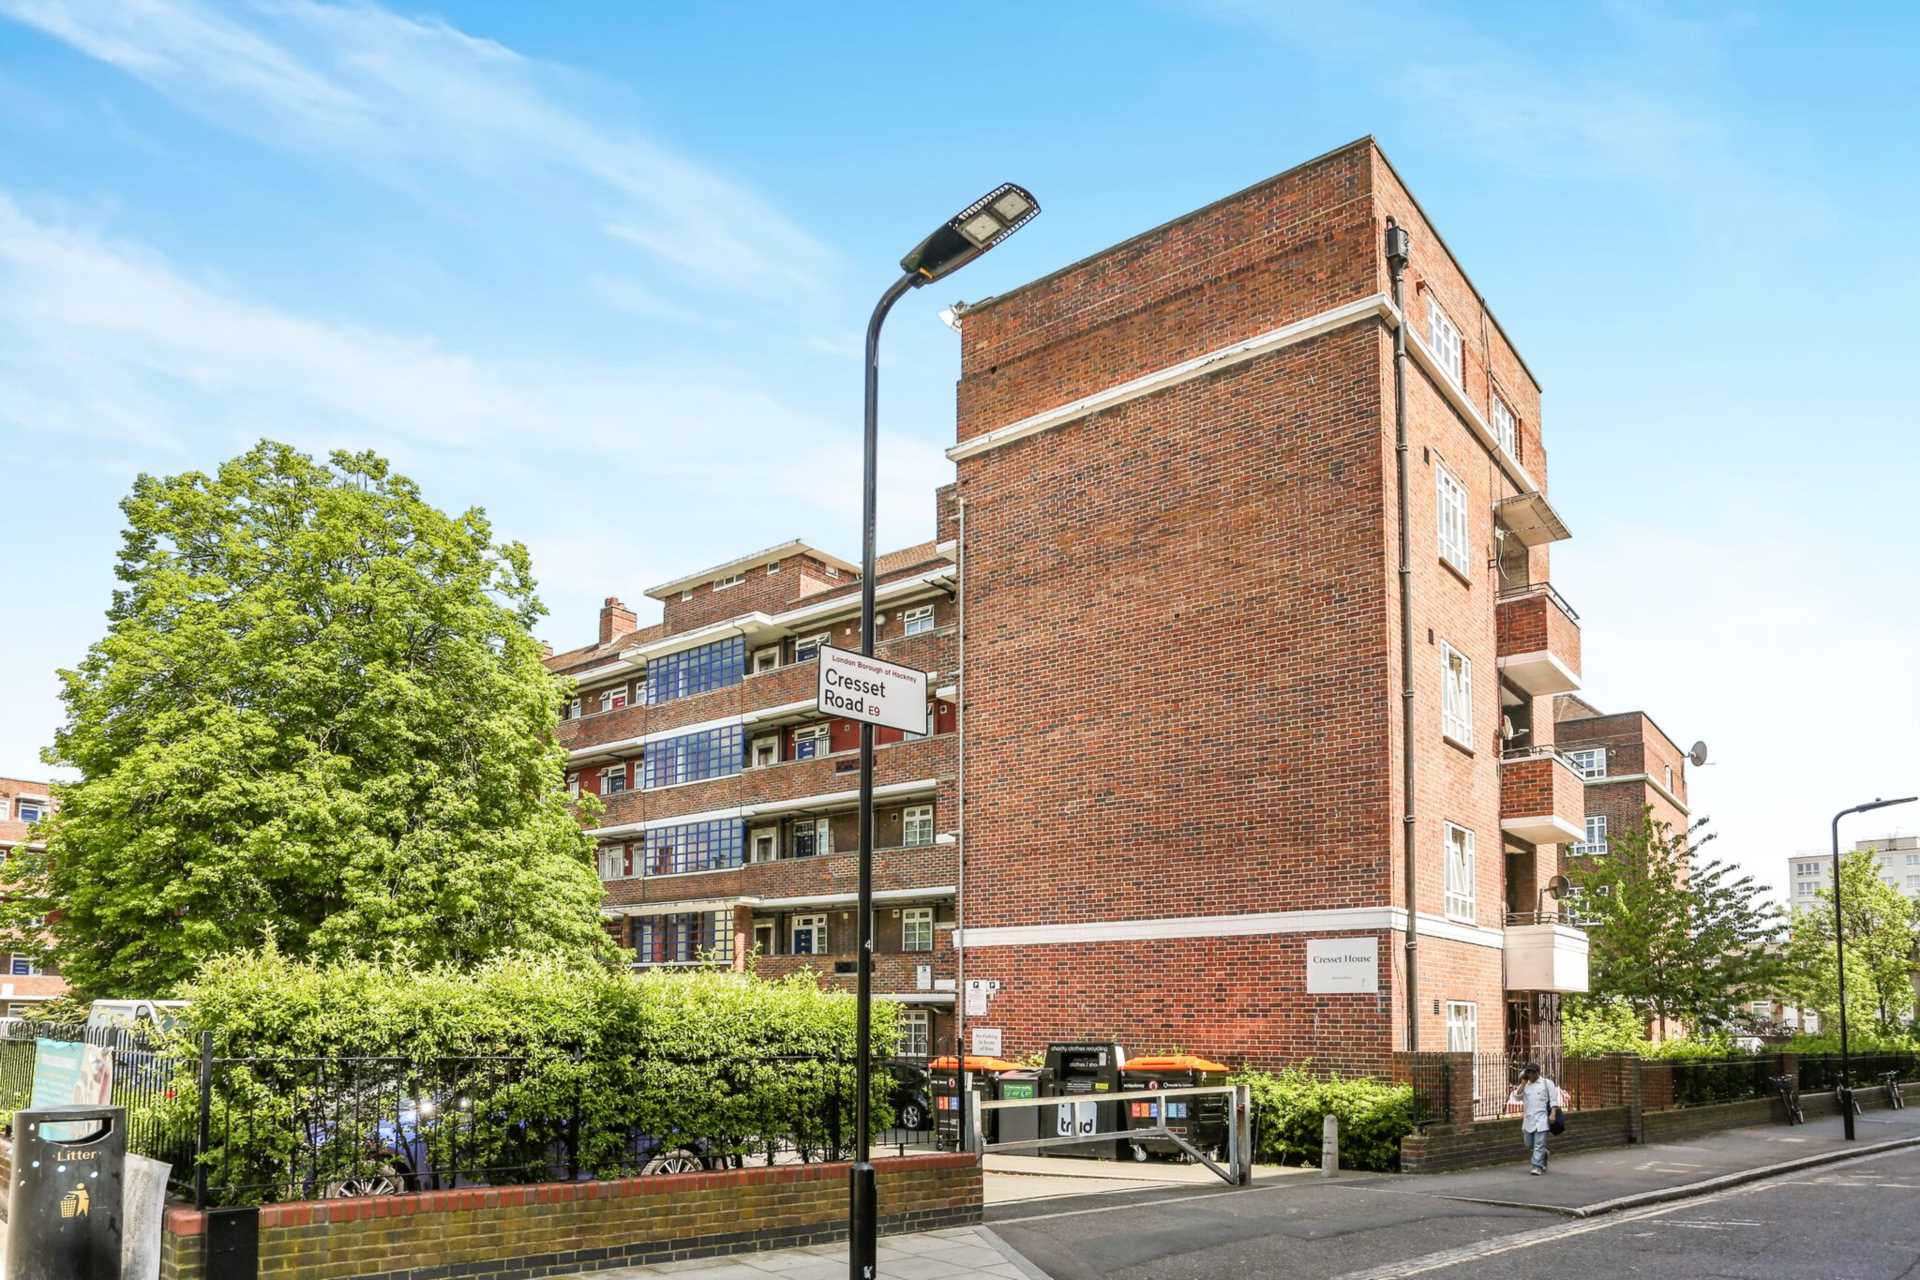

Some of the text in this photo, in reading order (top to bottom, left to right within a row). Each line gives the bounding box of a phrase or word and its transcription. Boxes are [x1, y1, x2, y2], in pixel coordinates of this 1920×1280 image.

[825, 668, 886, 698] Cresset
[831, 655, 856, 667] London
[857, 661, 883, 674] Borough
[891, 671, 917, 684] Hackney
[824, 689, 880, 717] Road E9
[1312, 954, 1371, 964] Cresset House
[57, 1150, 97, 1162] Litter
